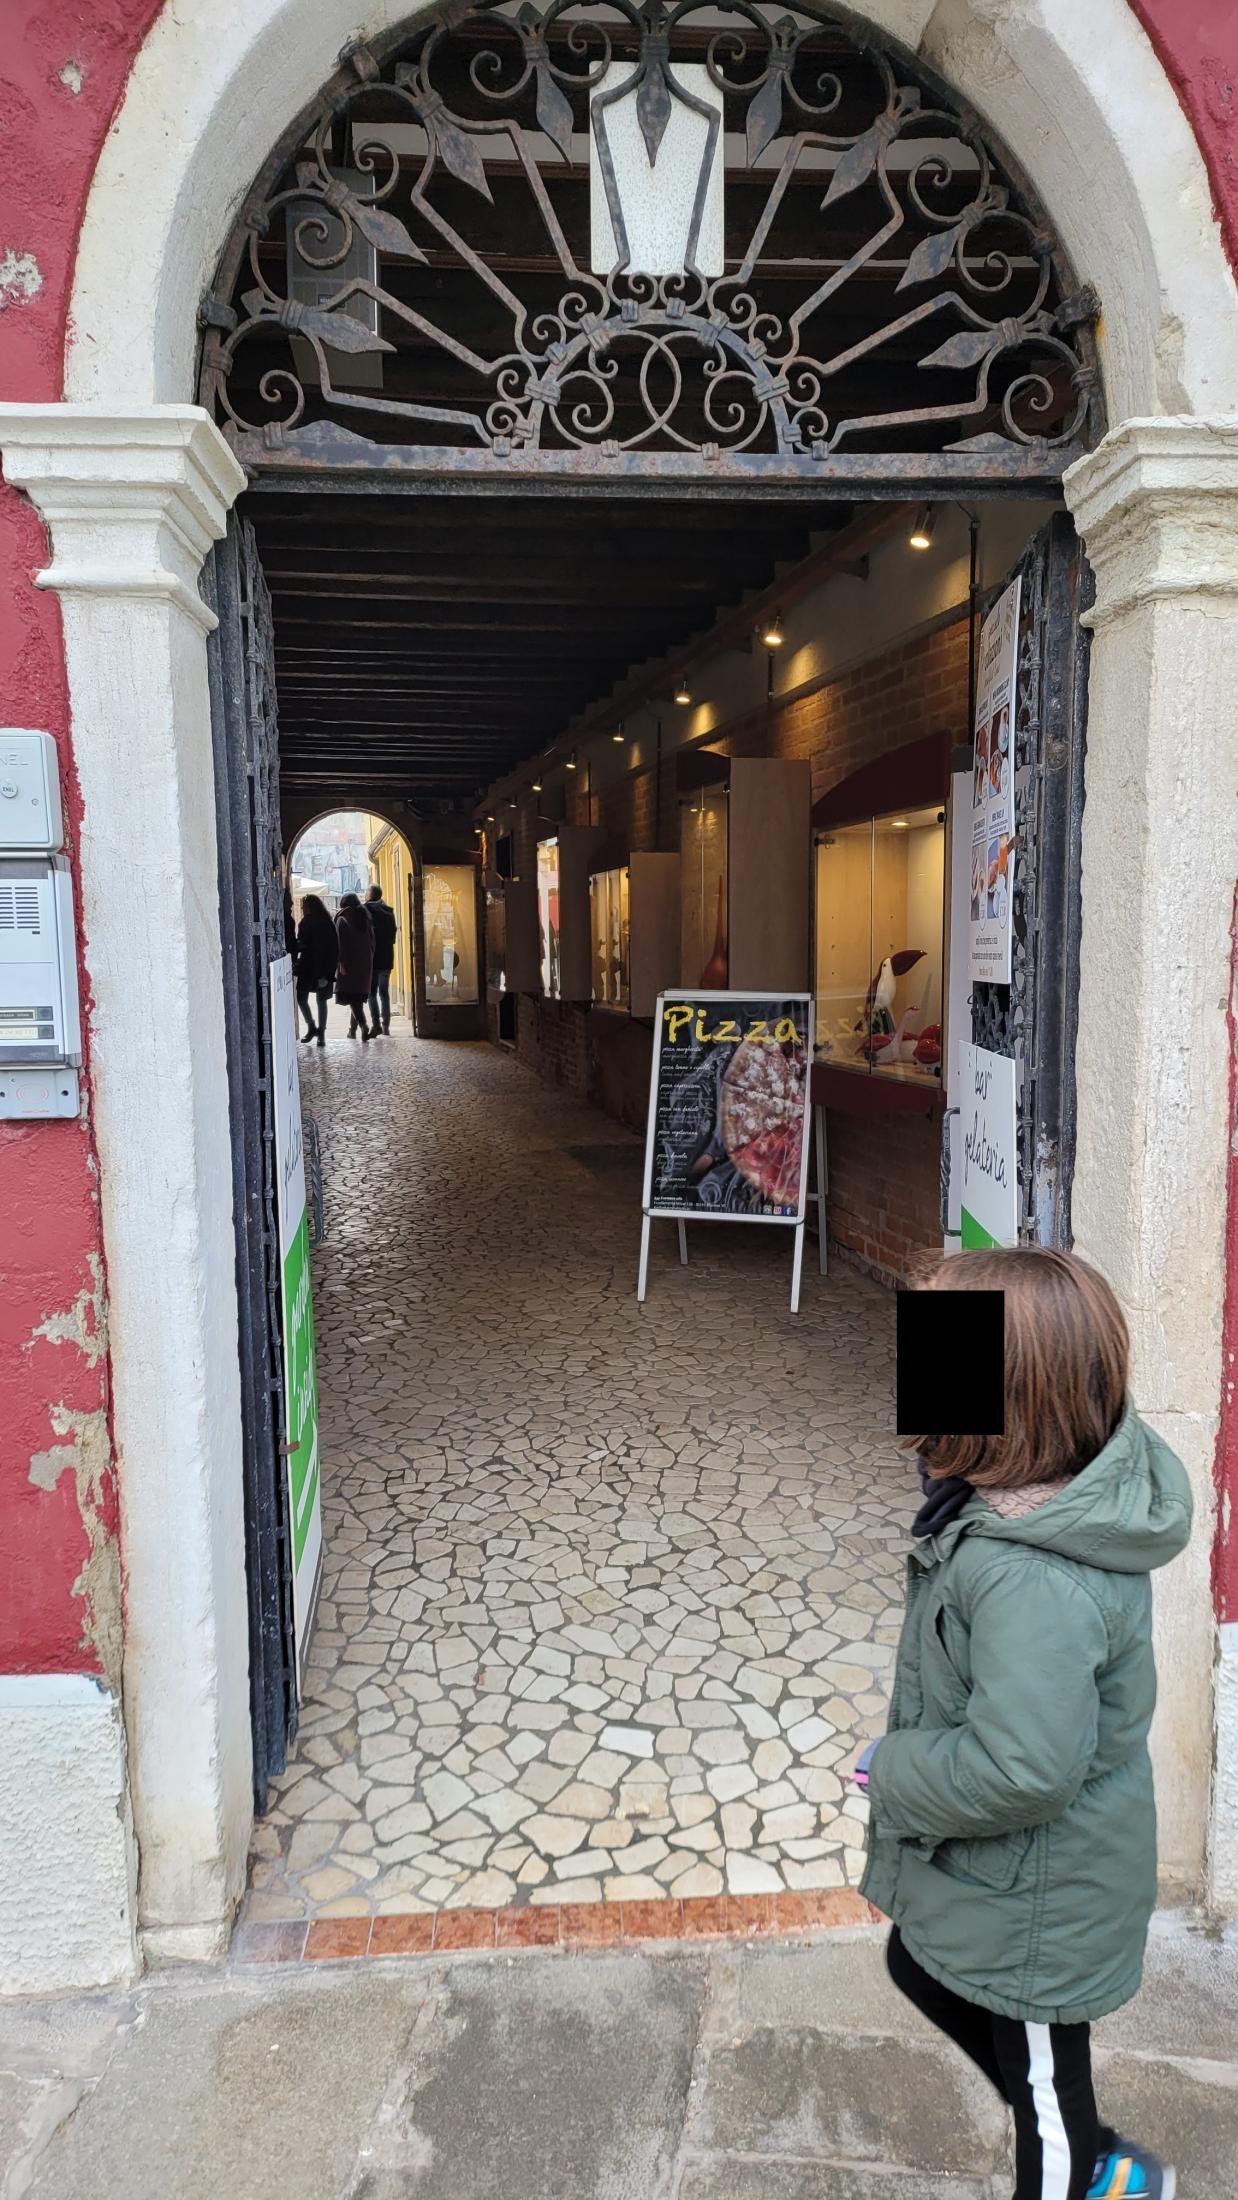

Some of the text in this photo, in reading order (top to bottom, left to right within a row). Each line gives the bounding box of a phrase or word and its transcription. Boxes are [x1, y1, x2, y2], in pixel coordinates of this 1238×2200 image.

[0, 753, 30, 766] NEL
[663, 1006, 802, 1044] Pizza
[975, 1047, 992, 1100] bar
[965, 1110, 1007, 1189] gelateria
